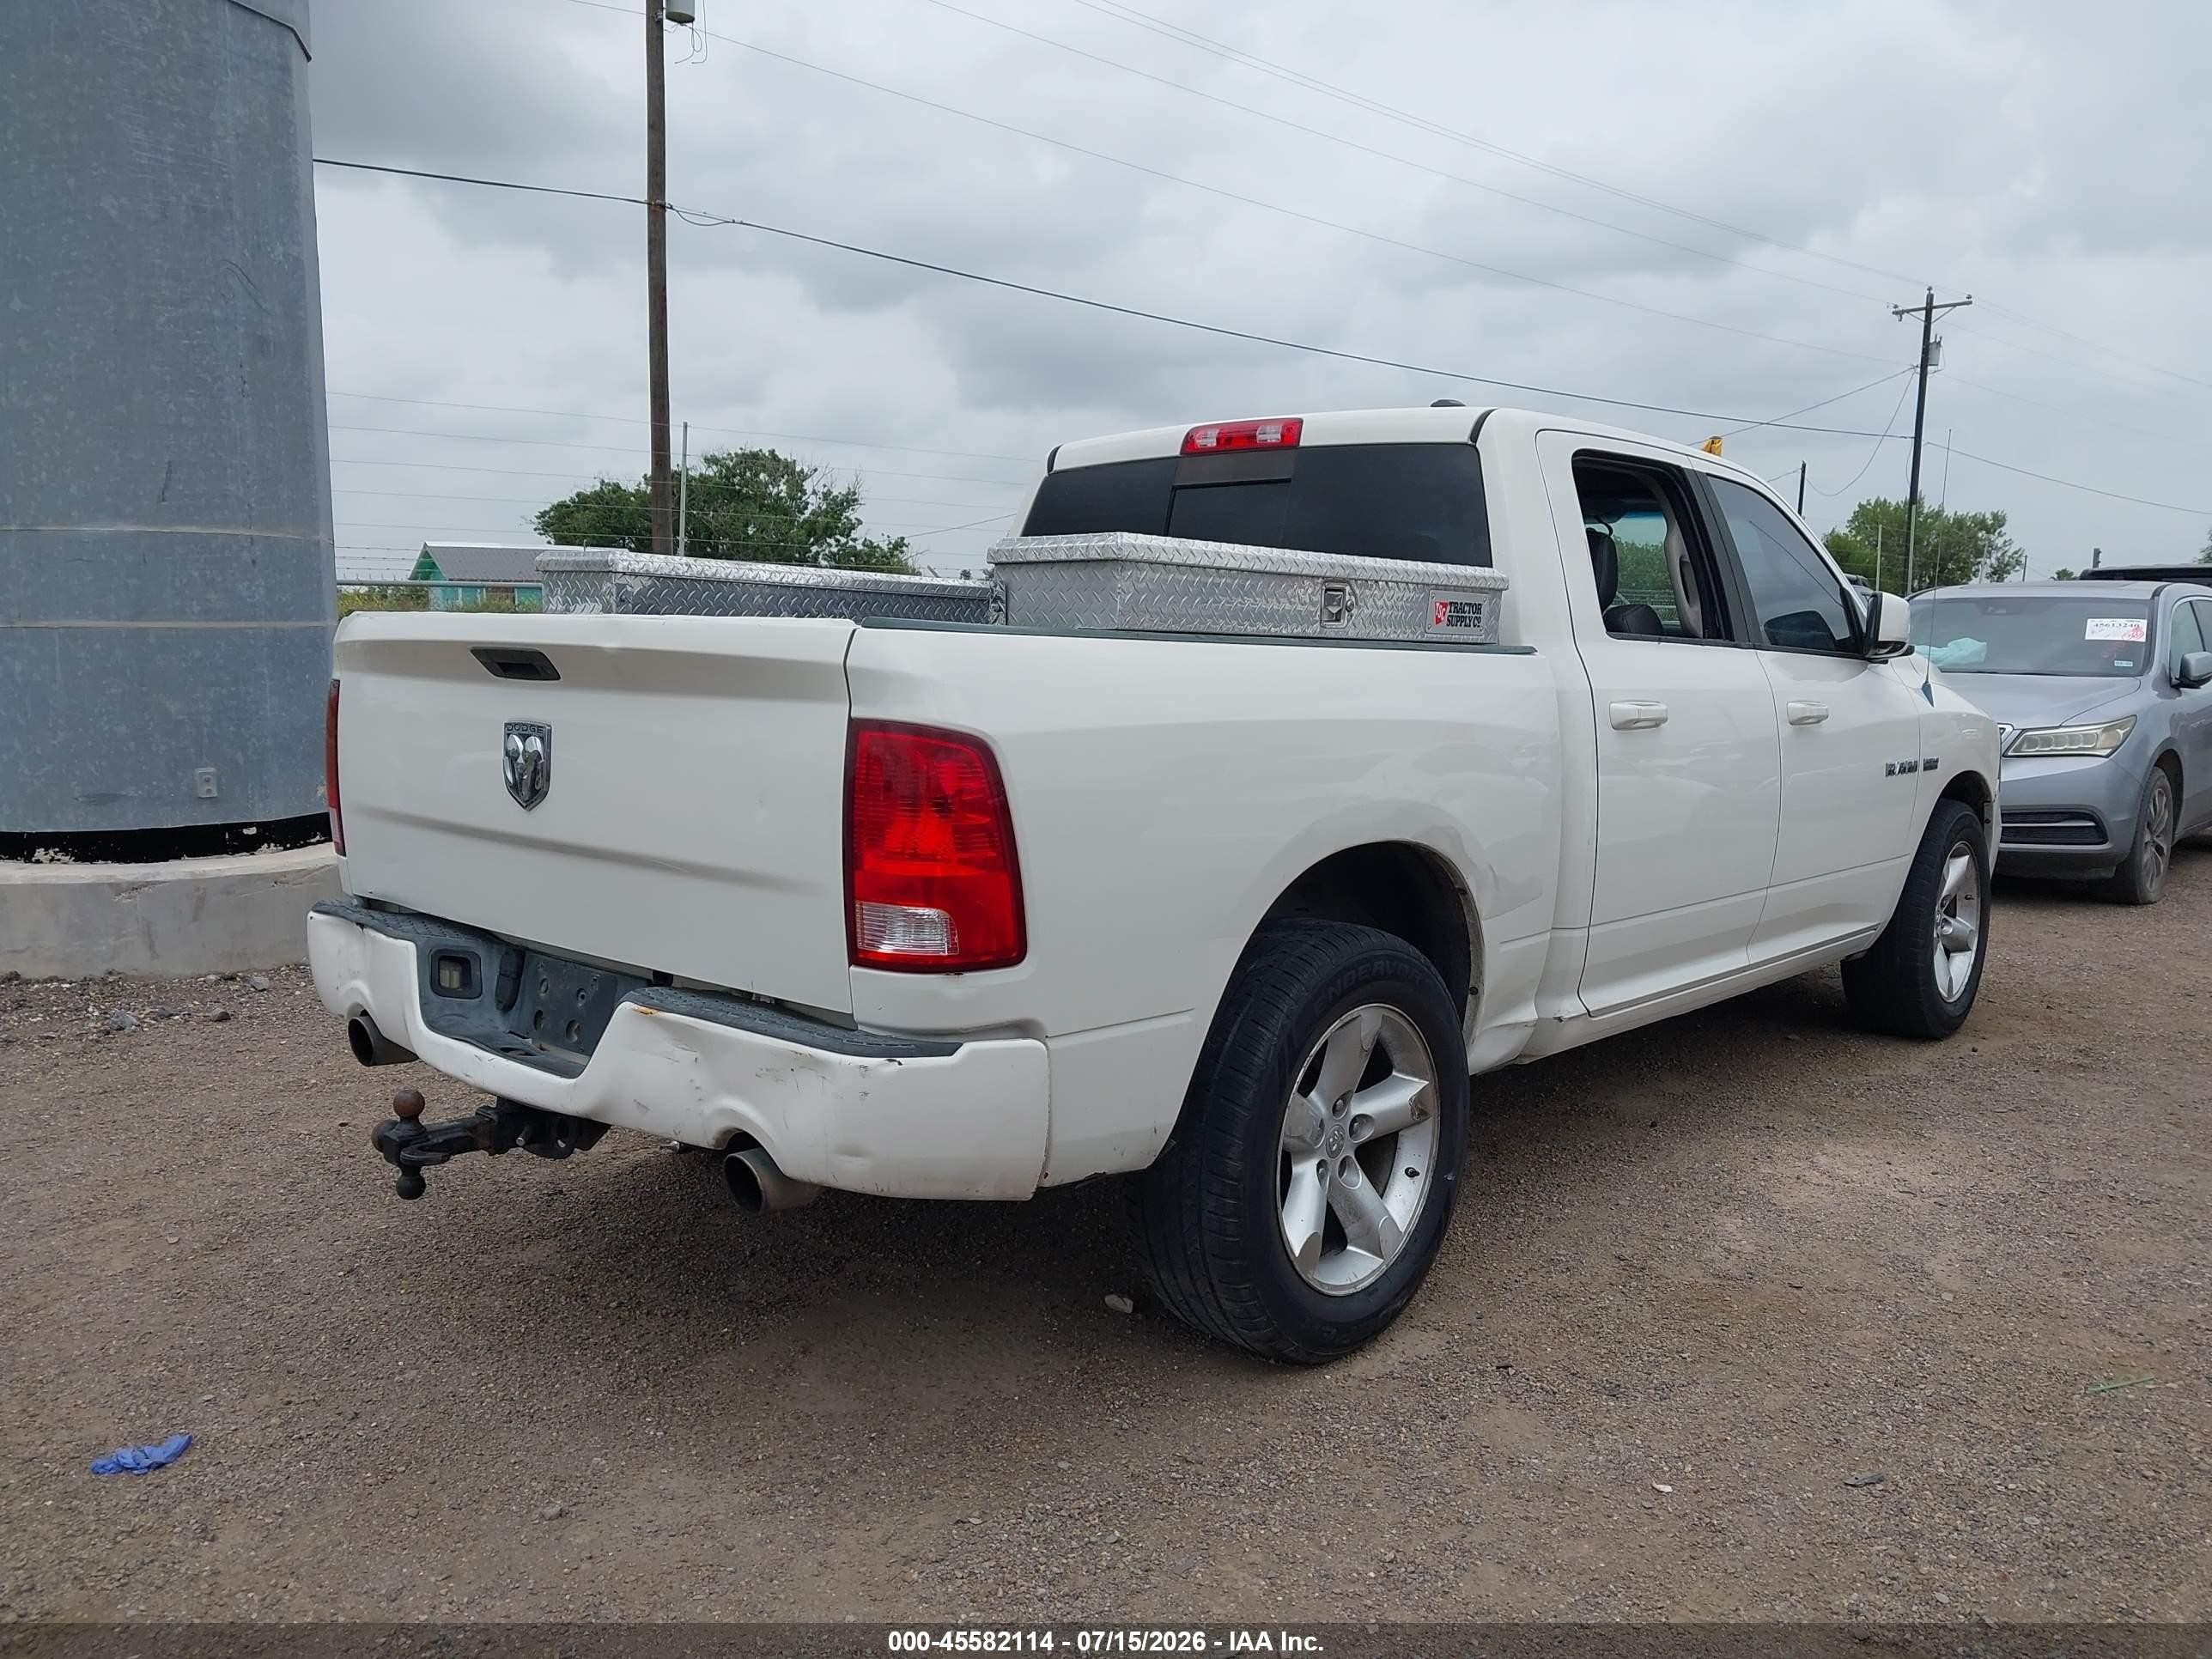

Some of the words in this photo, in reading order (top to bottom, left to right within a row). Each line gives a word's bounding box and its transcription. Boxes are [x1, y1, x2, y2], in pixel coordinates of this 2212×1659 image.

[1448, 601, 1482, 615] TRACTOR
[1446, 615, 1473, 628] SUPPLY
[507, 723, 544, 734] DODGE
